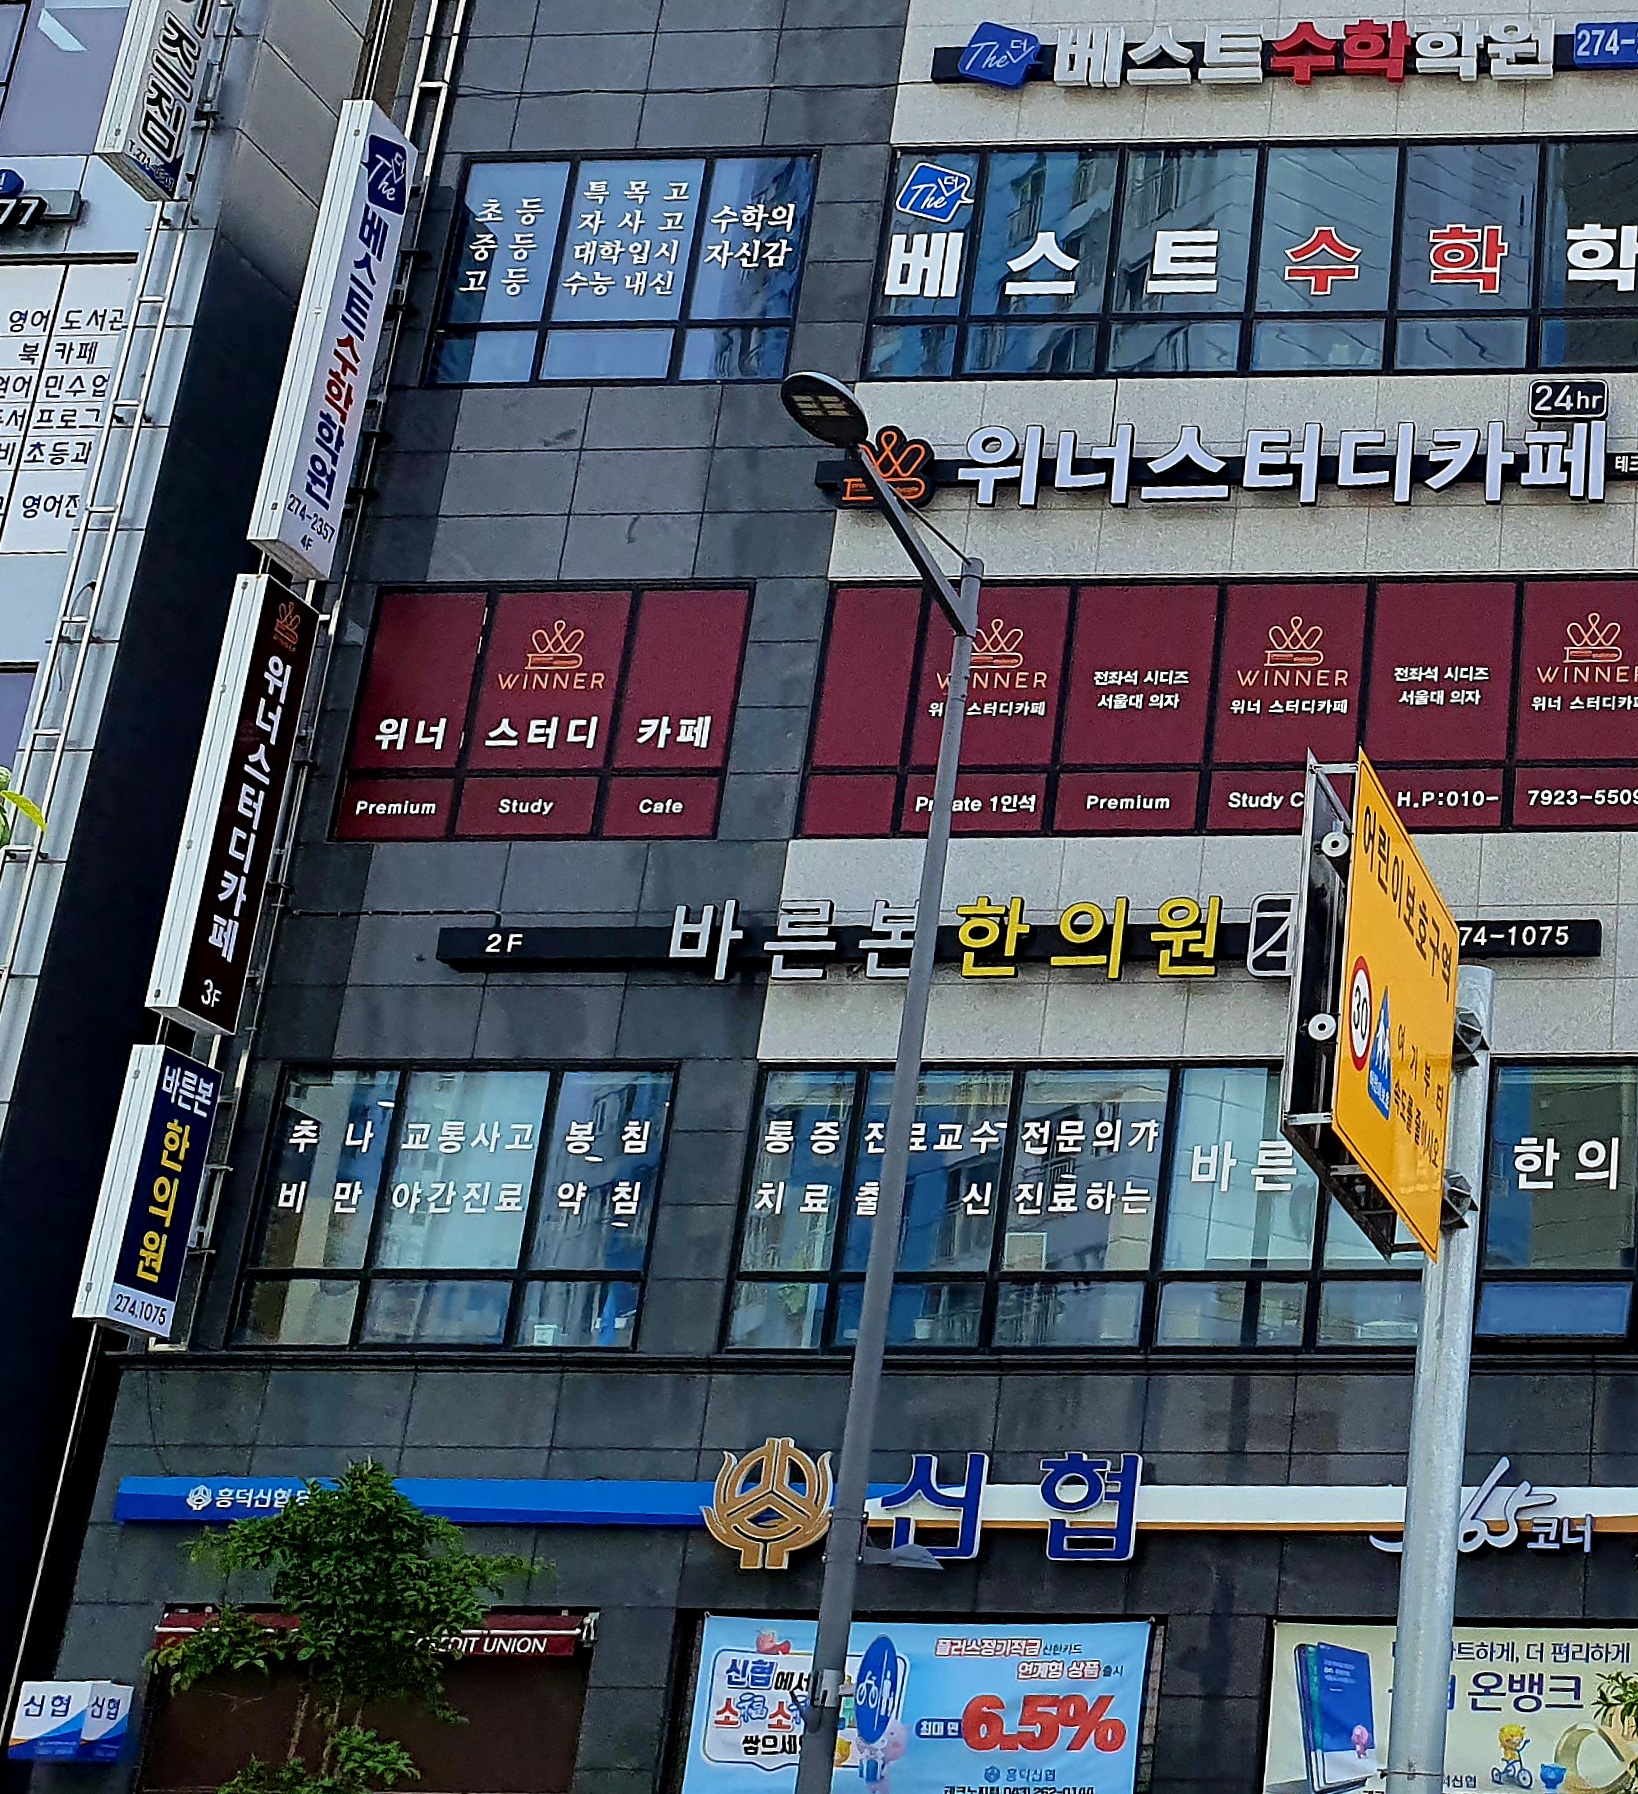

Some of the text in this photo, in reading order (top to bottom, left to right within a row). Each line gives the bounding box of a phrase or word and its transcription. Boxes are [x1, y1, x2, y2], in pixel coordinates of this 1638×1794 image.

[965, 41, 1009, 71] The
[139, 0, 216, 163] 즈짐
[905, 181, 948, 210] The
[710, 203, 795, 233] 수학의
[573, 239, 678, 265] 대학입시
[703, 240, 793, 269] 자신감
[562, 270, 674, 296] 수능 내신
[9, 310, 50, 332] 영어
[18, 342, 98, 365] 북 카페
[1533, 384, 1603, 412] 24hr
[959, 420, 1607, 507] 위너스터디카페
[287, 493, 336, 542] 274-2357
[300, 534, 313, 551] 4F
[498, 672, 605, 691] WINNER
[936, 671, 1048, 690] WNNER
[1093, 669, 1190, 686] 전좌석 시디즈
[1236, 668, 1349, 688] WINNER
[1393, 665, 1490, 683] 전좌석 시디즈
[966, 700, 1046, 717] 스터디카페
[1097, 693, 1181, 711] 서울대 의자
[1229, 697, 1349, 715] 위너 스터디카페
[1399, 689, 1481, 707] 서울대 의자
[1531, 695, 1563, 712] 위너
[375, 715, 712, 751] 위너 스터디 카페
[208, 655, 292, 963] 위너스터디카페
[355, 798, 683, 816] Premium Study Cafe
[915, 794, 1036, 813] Prate 1인석
[1086, 794, 1170, 810] Premium
[1228, 791, 1284, 811] Study
[1362, 804, 1452, 1003] 어린이보호구역
[485, 933, 524, 953] 2F
[201, 979, 222, 1007] 3F
[1352, 984, 1370, 1041] 30
[162, 1065, 213, 1118] 바른본
[402, 1121, 533, 1153] 교통사고
[137, 1119, 191, 1283] 한의원
[392, 1181, 523, 1213] 야간진료
[1013, 1181, 1150, 1214] 진료하는
[114, 1294, 167, 1326] 274.1075
[881, 1452, 1143, 1560] 신협
[1526, 1514, 1592, 1553] 코너
[482, 1637, 548, 1654] UNION
[1043, 1643, 1082, 1655] 신한카드
[1527, 1643, 1631, 1663] 더 편리하게
[1068, 1660, 1101, 1679] 상품
[1103, 1665, 1123, 1677] 출시
[1468, 1671, 1584, 1713] 온뱅크
[24, 1695, 72, 1717] 신협
[91, 1696, 121, 1720] 신협
[962, 1694, 1127, 1752] 6.5%
[742, 1735, 802, 1755] 쌓으세
